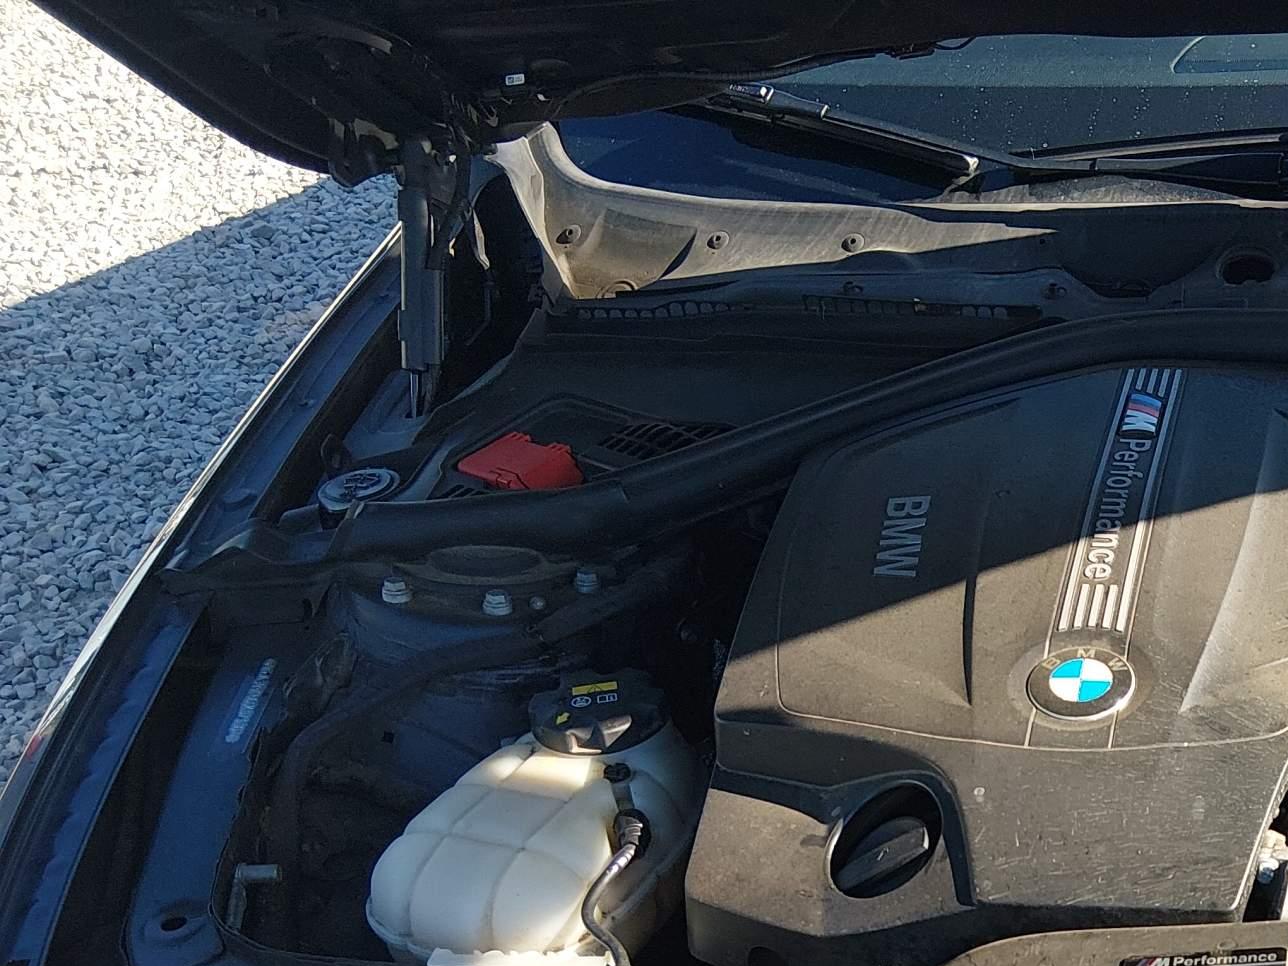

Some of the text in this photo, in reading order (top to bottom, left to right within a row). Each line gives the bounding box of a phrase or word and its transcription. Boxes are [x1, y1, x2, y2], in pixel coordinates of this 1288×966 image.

[873, 495, 931, 577] BMW
[1084, 438, 1152, 580] Performance
[1041, 647, 1128, 671] BMW
